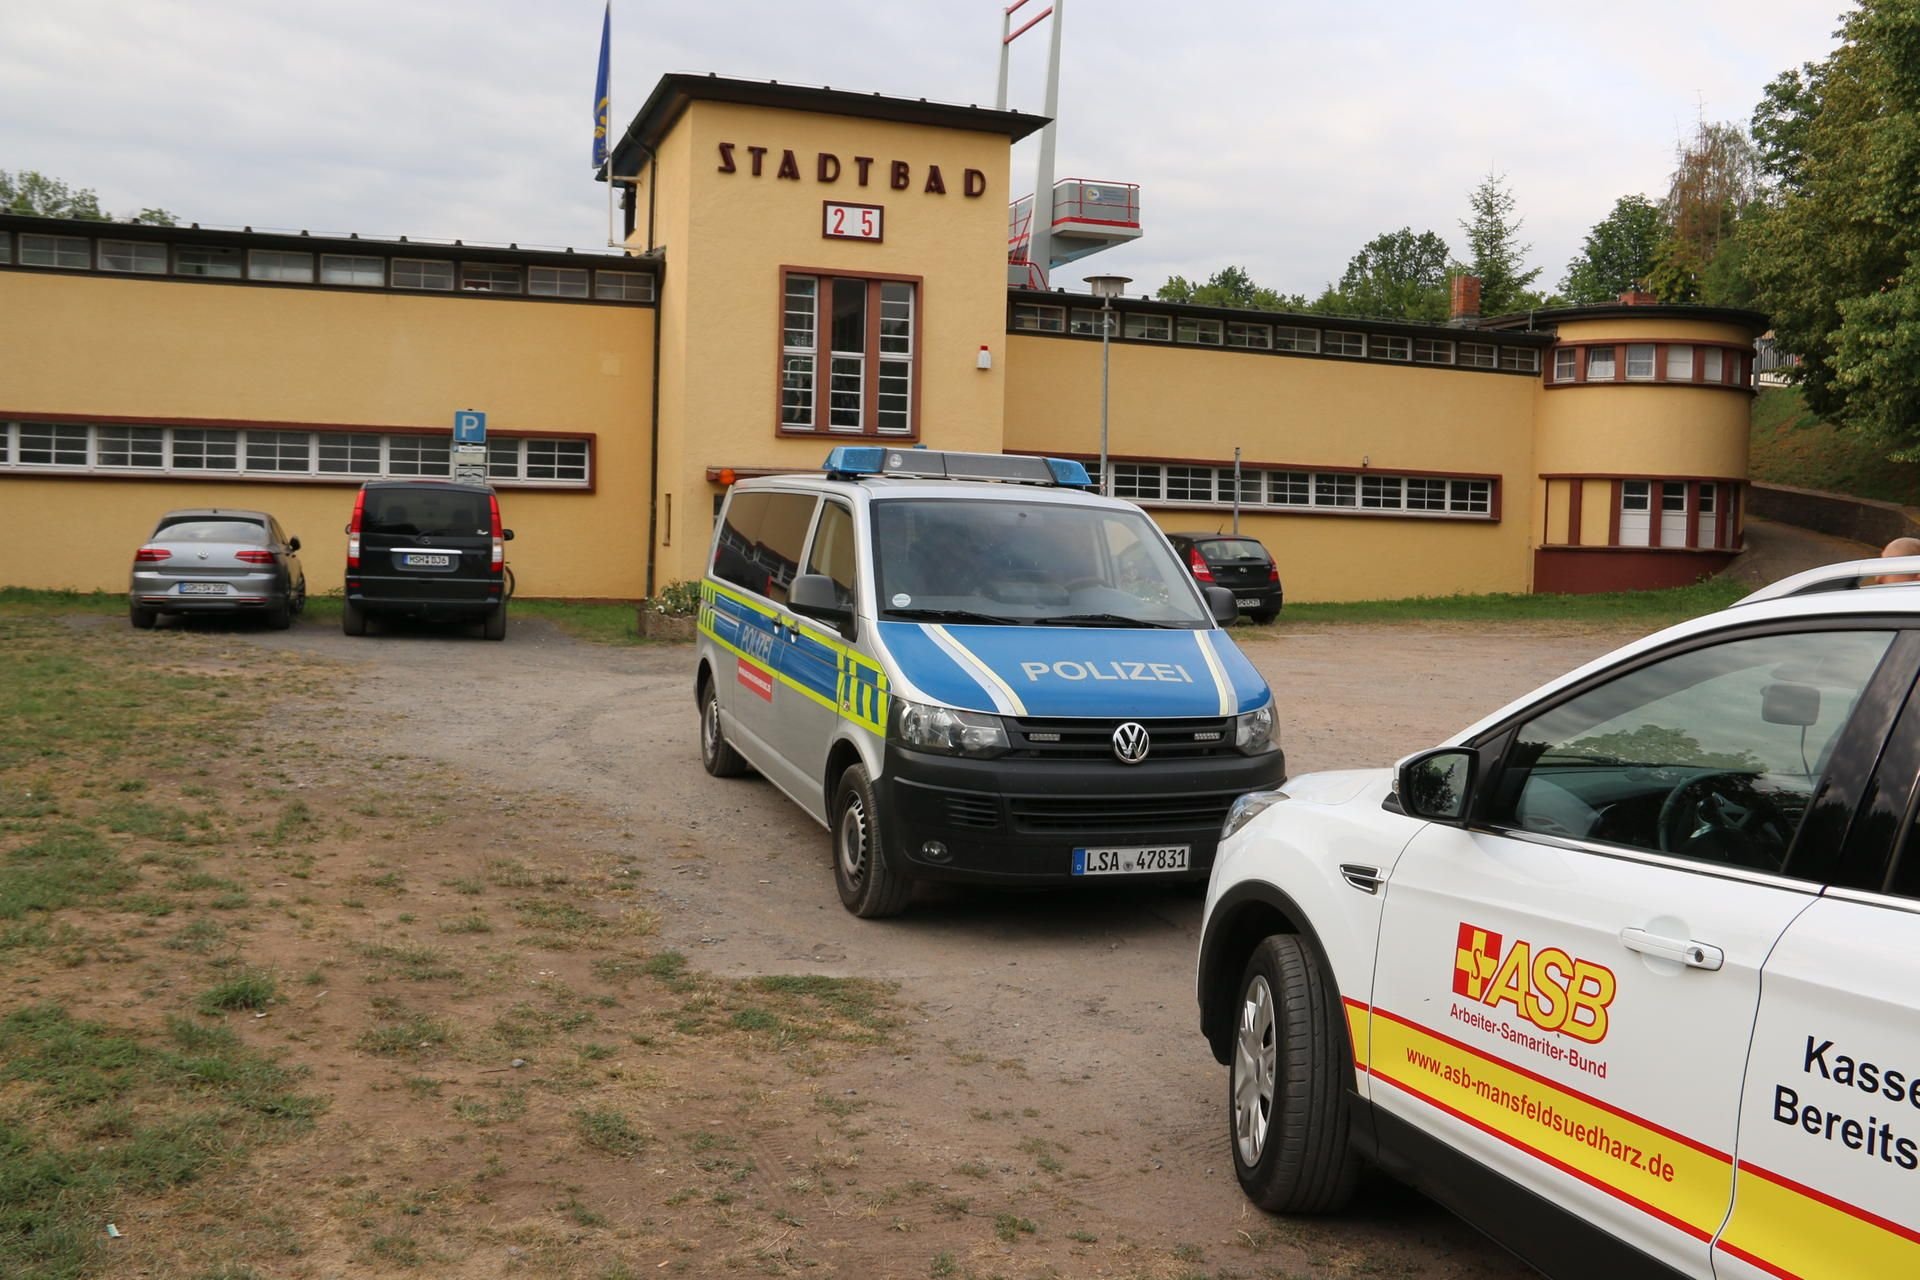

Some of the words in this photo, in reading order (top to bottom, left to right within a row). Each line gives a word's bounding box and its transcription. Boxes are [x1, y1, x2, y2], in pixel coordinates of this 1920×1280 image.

[718, 142, 986, 198] STADTBAD
[833, 208, 873, 236] 25
[462, 415, 479, 438] P
[741, 625, 774, 665] POLIZEI
[1020, 661, 1193, 683] POLIZEI
[1087, 852, 1119, 872] LSA
[1136, 849, 1186, 870] 47831
[1483, 940, 1617, 1045] ASB
[1450, 1003, 1607, 1080] Arbeiter-Samariter-Bund
[1406, 1047, 1675, 1183] www.asb-mansfeldsuedharz.de
[1773, 1084, 1918, 1170] Bereits
